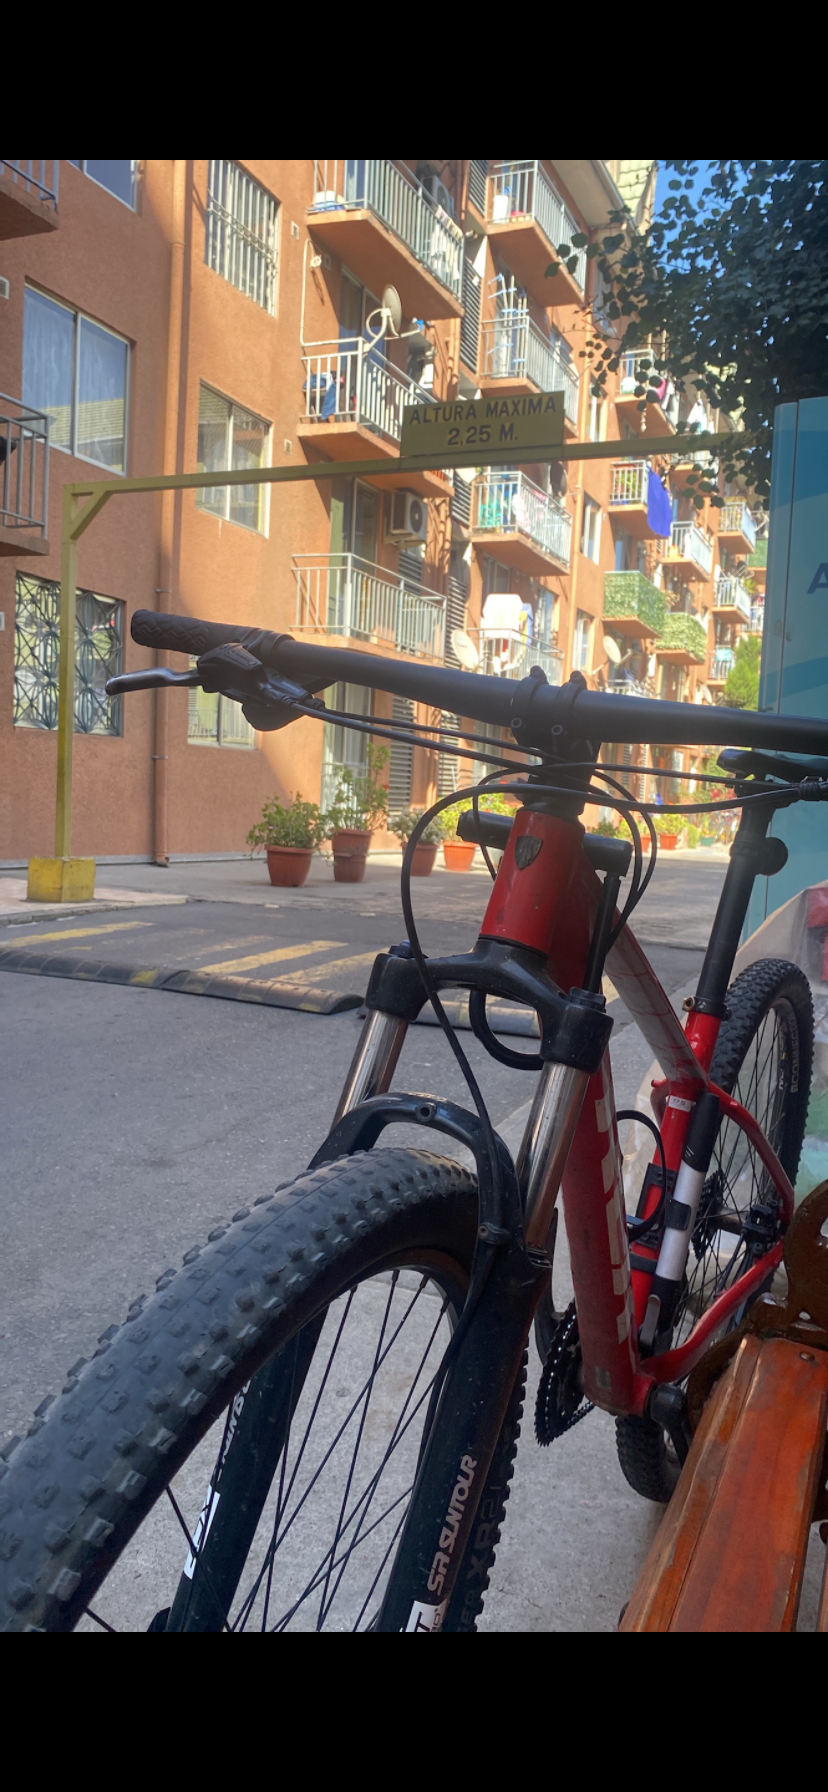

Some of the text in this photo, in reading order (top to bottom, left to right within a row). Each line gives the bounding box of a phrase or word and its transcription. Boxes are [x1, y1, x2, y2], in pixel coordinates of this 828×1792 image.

[409, 396, 557, 425] ALTURA MAXIMA
[499, 422, 519, 442] M.
[438, 1455, 478, 1553] SUNTOUR
